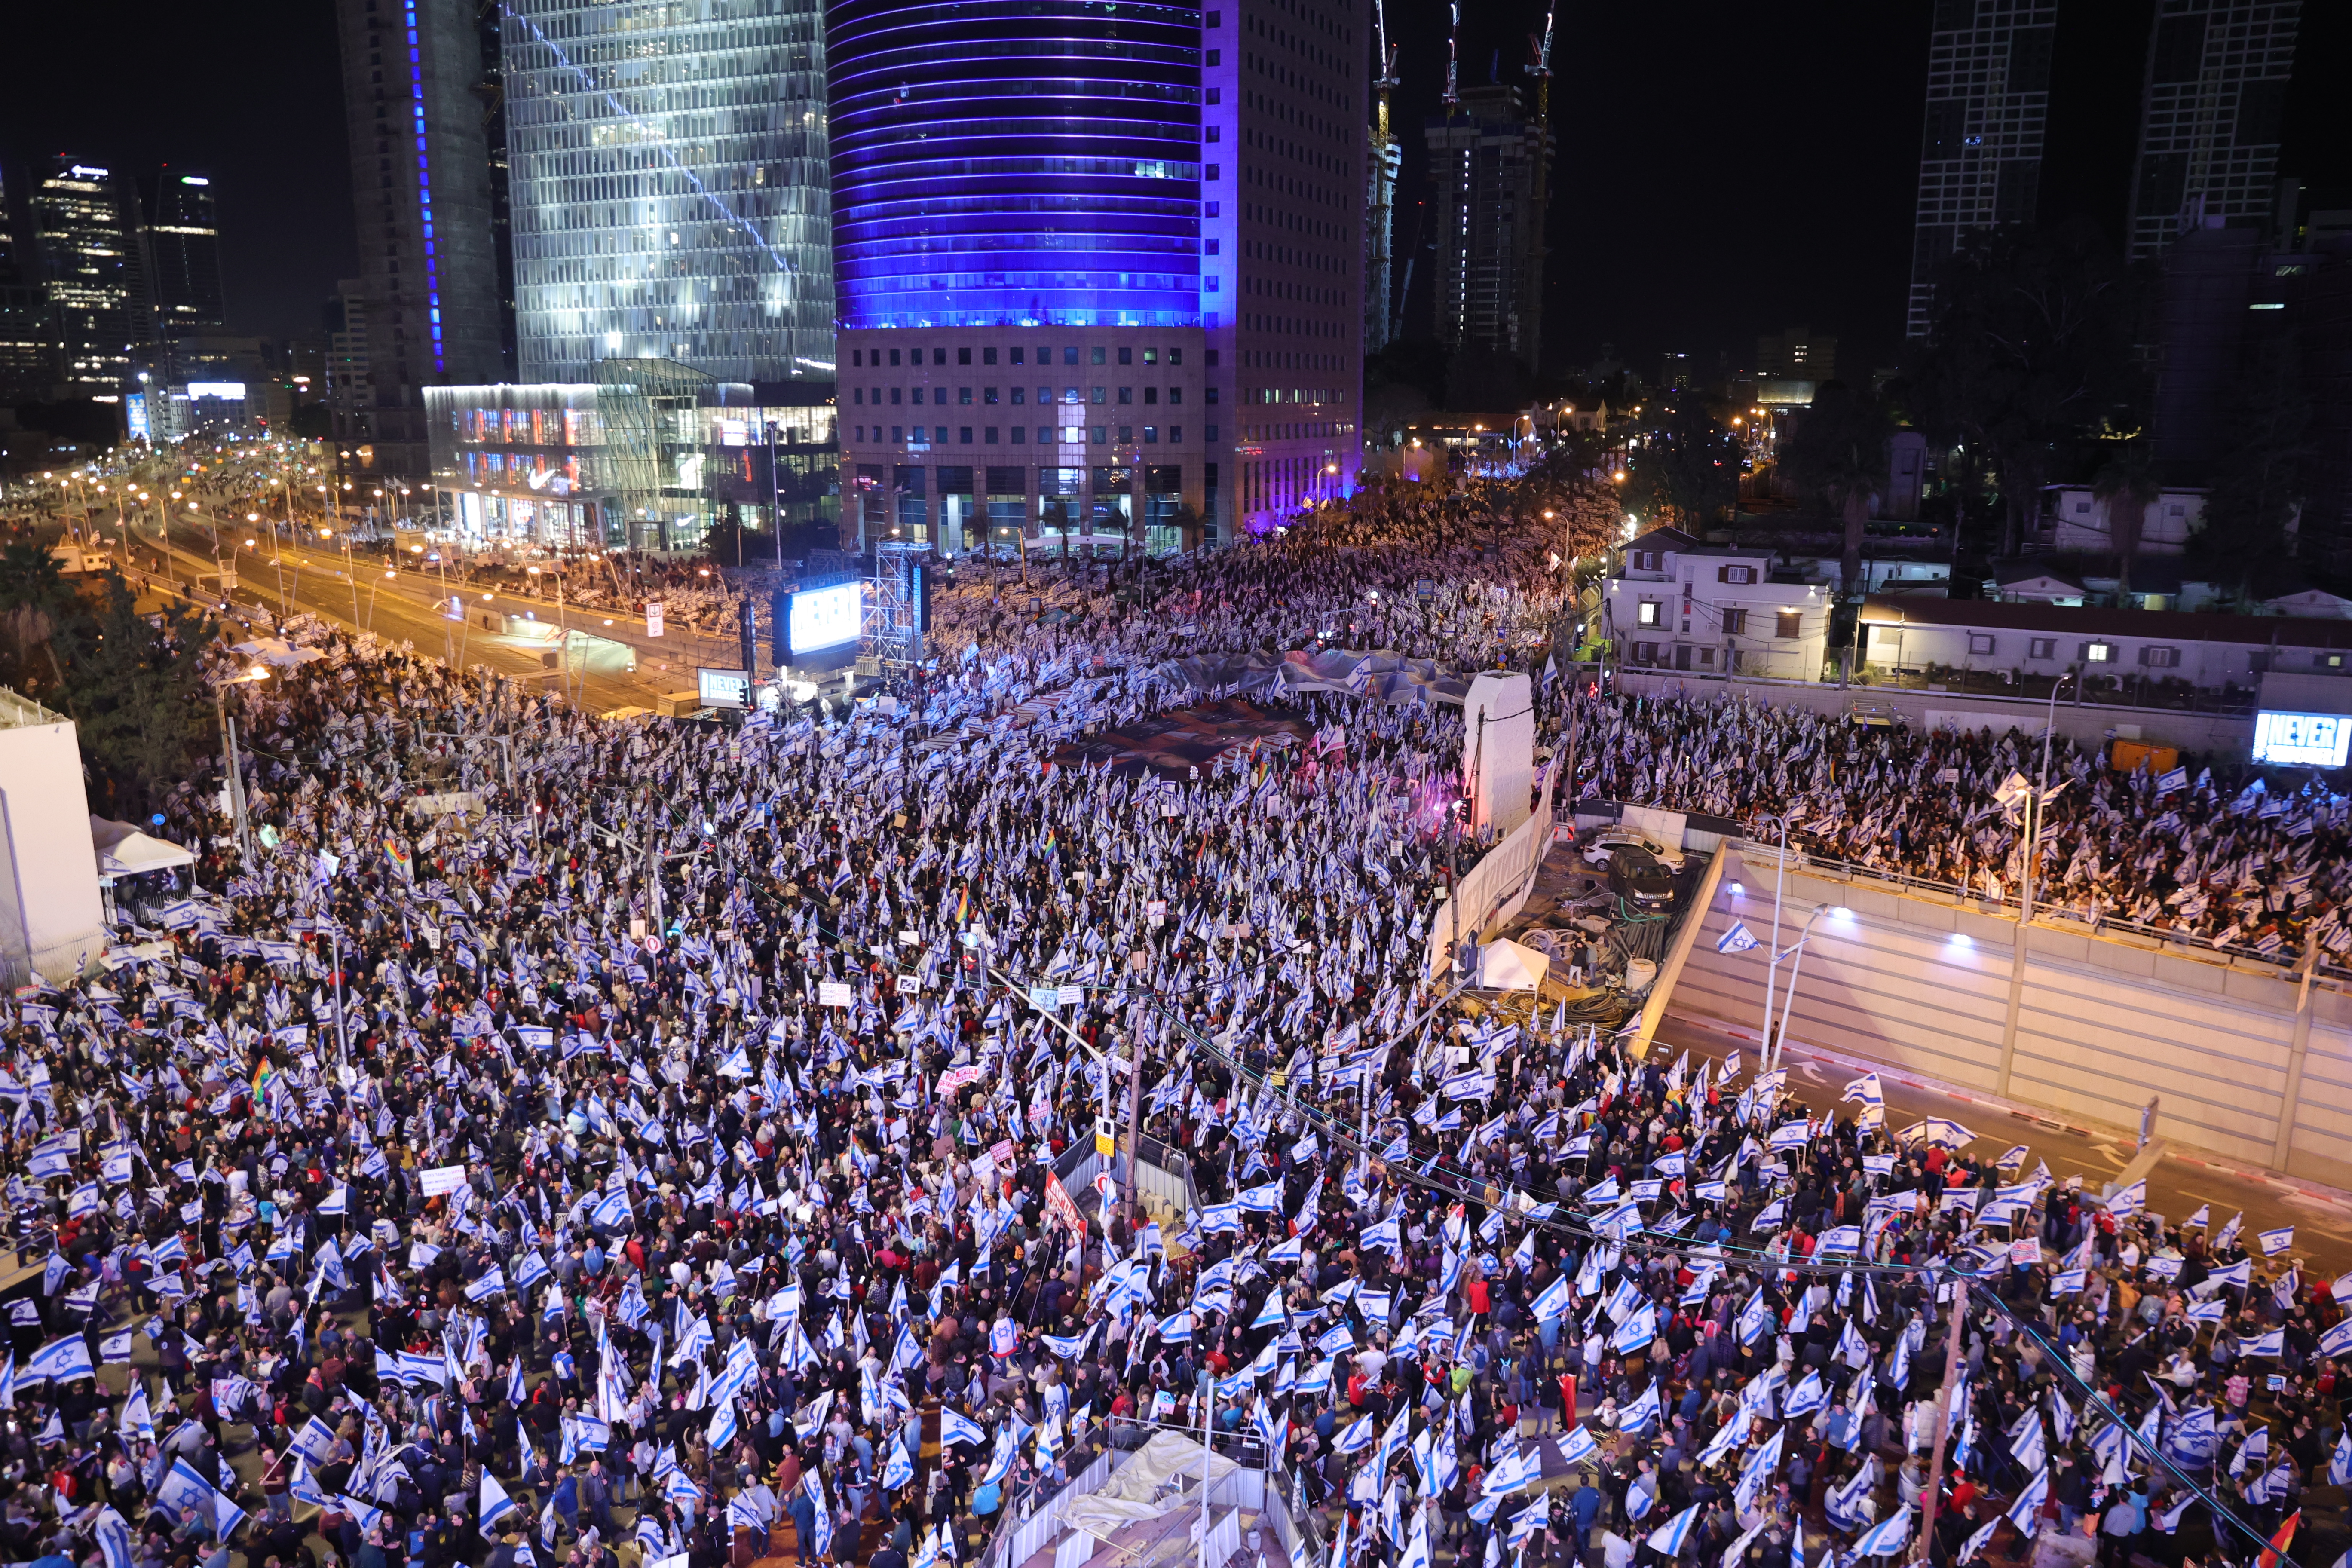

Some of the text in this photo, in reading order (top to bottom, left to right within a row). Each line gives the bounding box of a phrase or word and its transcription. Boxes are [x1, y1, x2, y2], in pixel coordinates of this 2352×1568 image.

[129, 399, 145, 408] 2.3
[710, 674, 743, 692] NEVER
[2268, 714, 2337, 748] NEVER
[936, 1086, 953, 1095] ISRAEL
